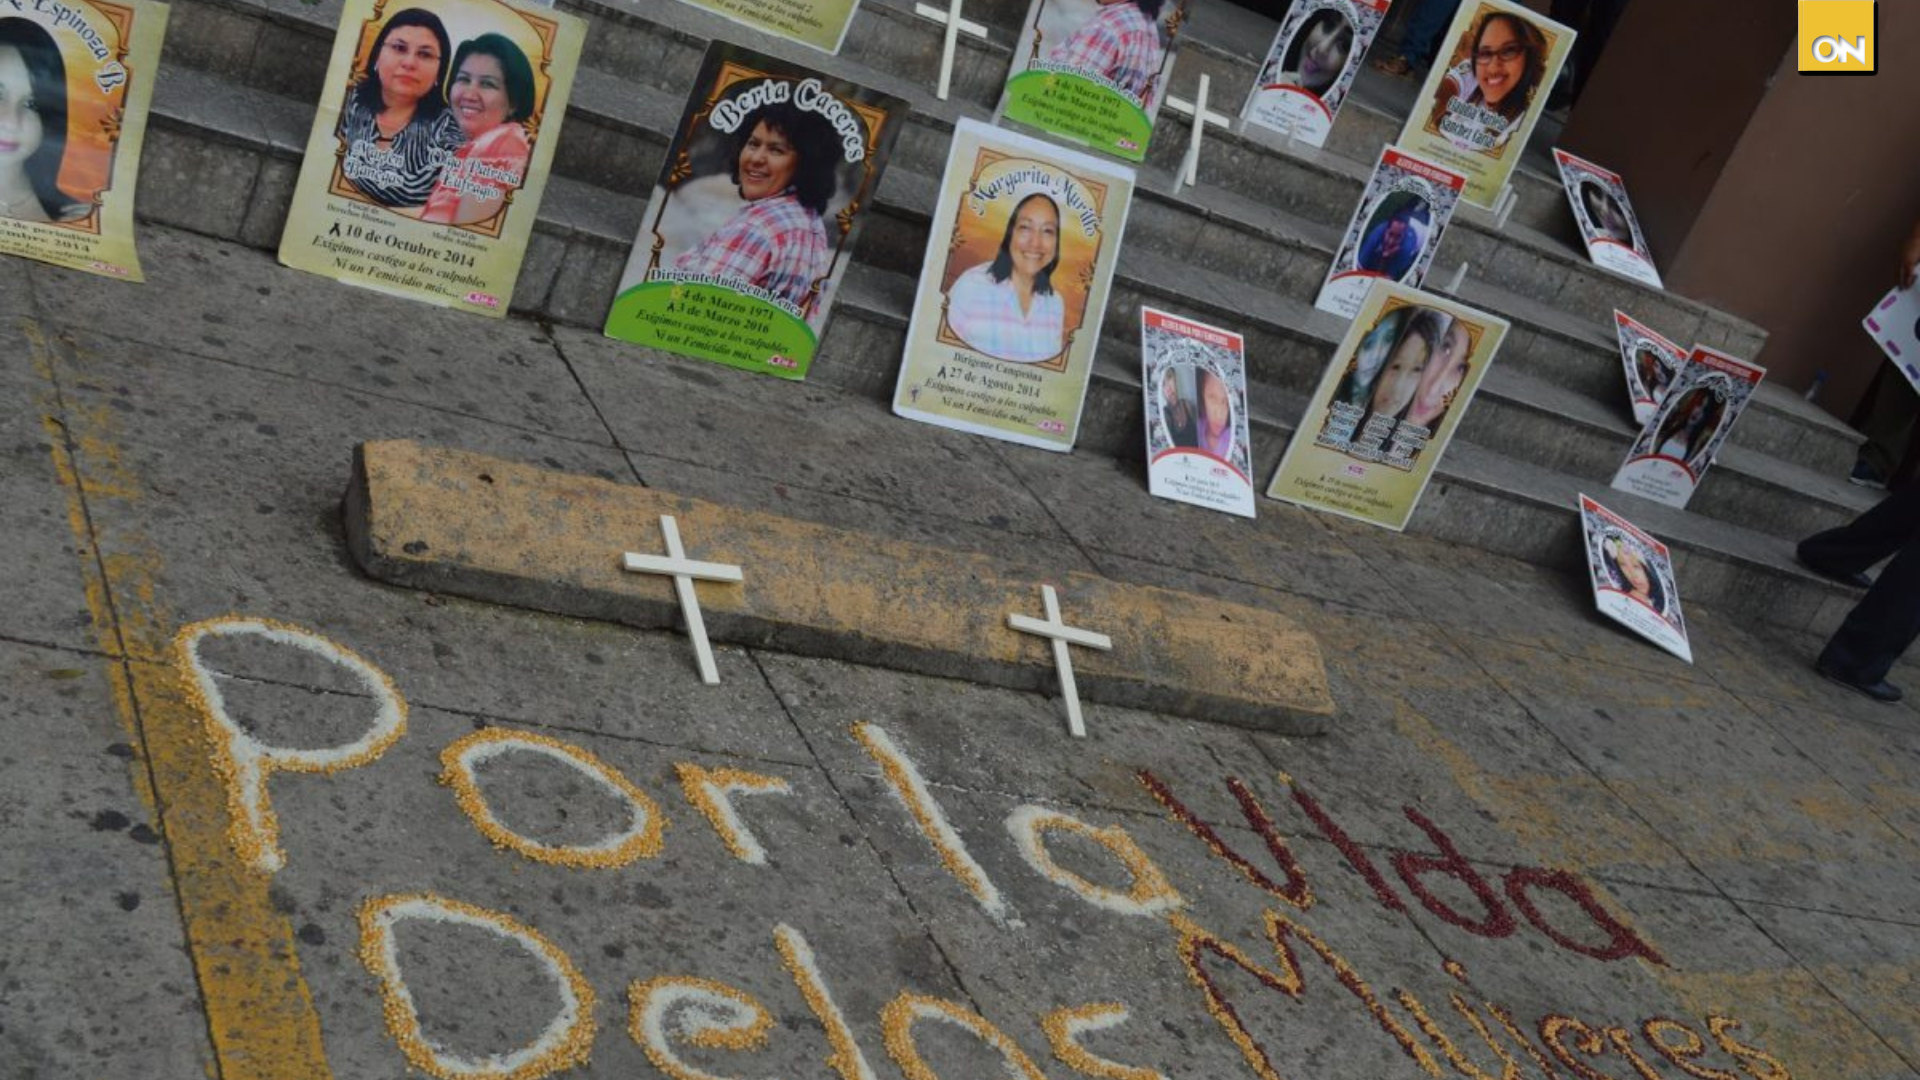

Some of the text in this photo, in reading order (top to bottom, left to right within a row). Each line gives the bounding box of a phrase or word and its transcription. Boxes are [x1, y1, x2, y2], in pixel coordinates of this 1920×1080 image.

[710, 78, 865, 163] Berta Caceres
[971, 166, 1050, 215] Margarita
[346, 224, 476, 268] 10 de Octubre 2014
[311, 235, 487, 289] Exigimos castigo a los culpables
[332, 257, 347, 270] Ni
[349, 263, 364, 274] un
[366, 265, 423, 288] Femicidio
[651, 268, 713, 285] Dirigente
[769, 293, 803, 318] Lenca
[682, 289, 774, 320] 4 de Marzo 1971
[635, 309, 682, 328] Exigimos
[678, 303, 770, 334] 3 de Marzo 2016
[667, 333, 679, 343] un
[950, 367, 1041, 398] 27 de Agosto 2014
[954, 352, 1043, 382] Dirigente Campesina
[924, 377, 964, 394] Exigimos
[965, 389, 996, 403] castigo
[1004, 397, 1017, 408] los
[952, 402, 964, 411] un
[174, 613, 793, 874] Por
[850, 720, 1183, 927] la
